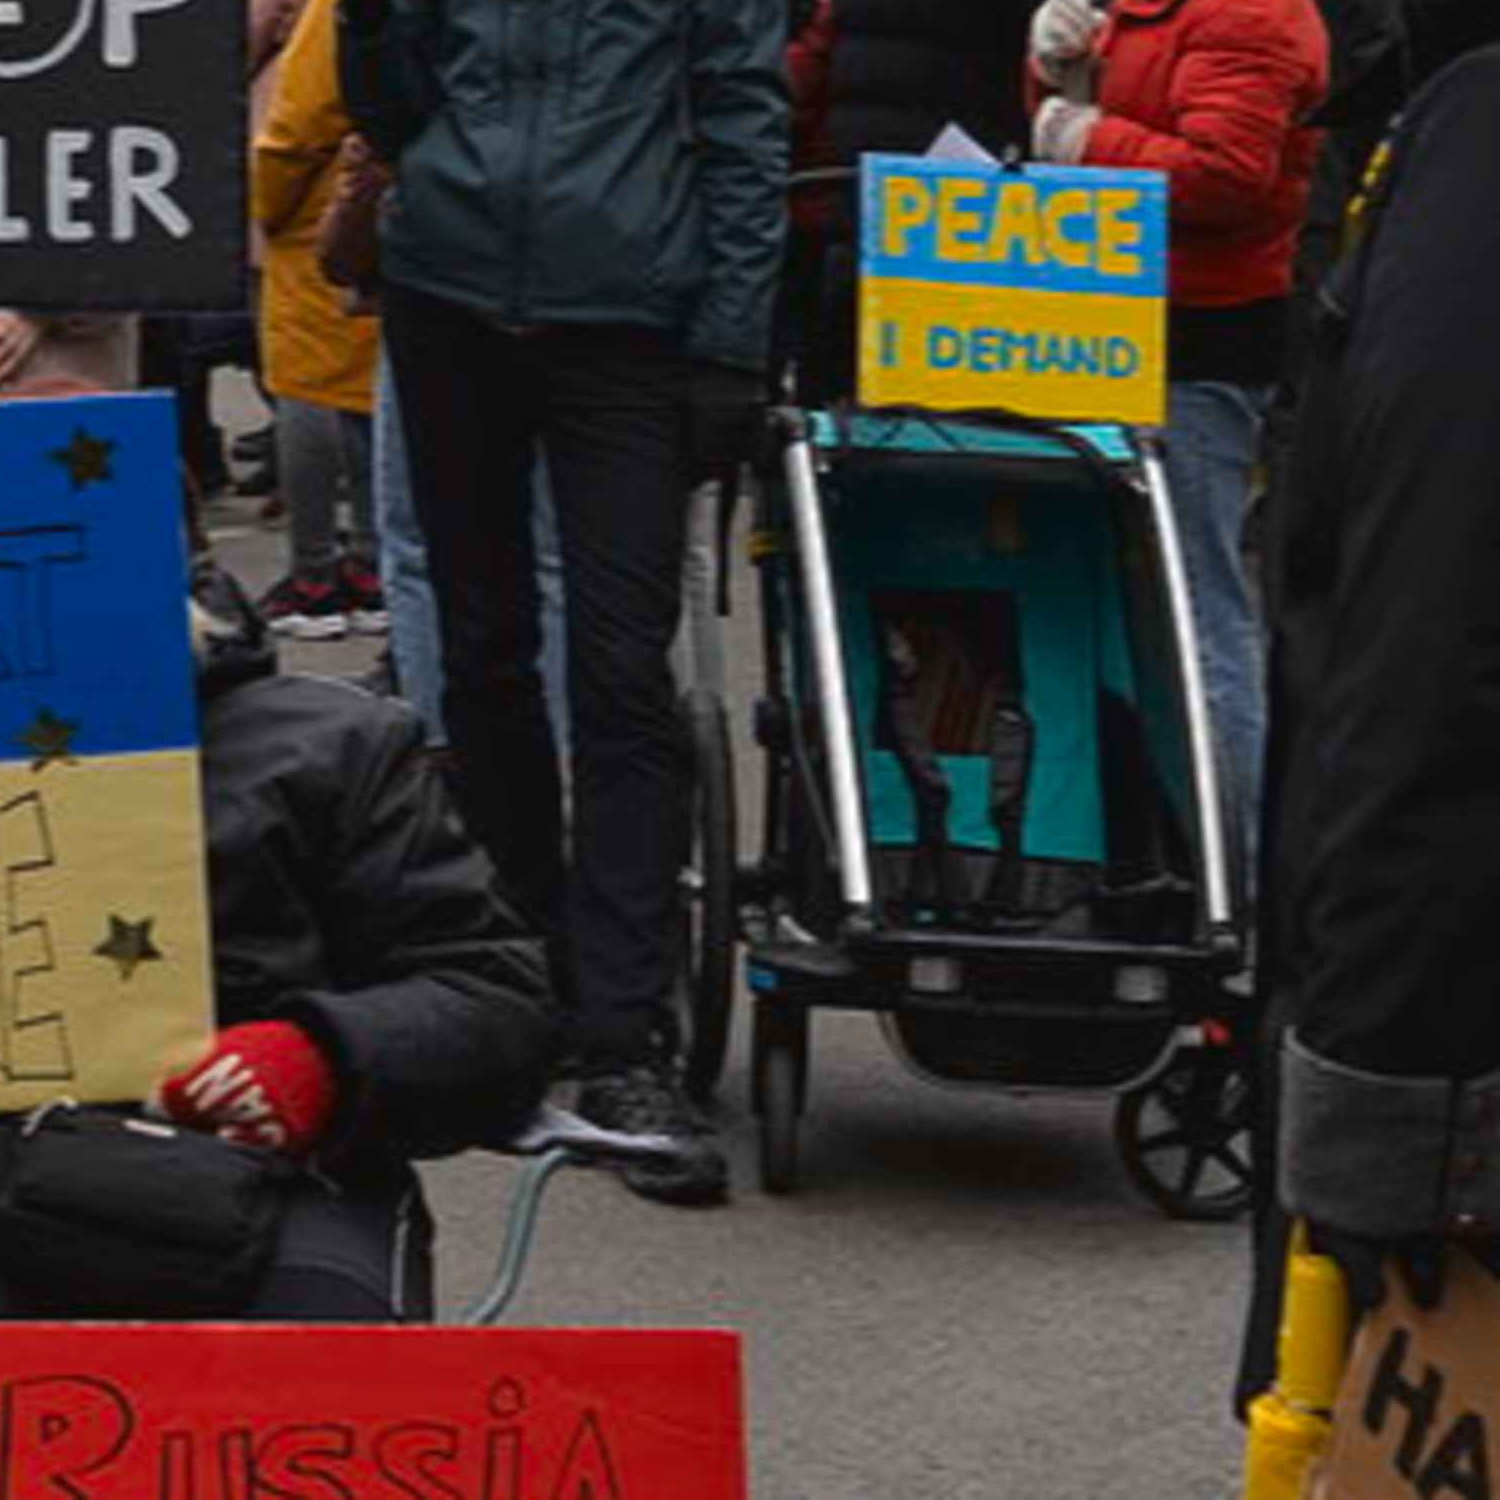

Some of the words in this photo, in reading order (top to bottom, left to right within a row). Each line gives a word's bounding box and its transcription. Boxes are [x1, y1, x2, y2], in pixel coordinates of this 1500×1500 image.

[881, 175, 1143, 276] PEACE
[879, 321, 899, 368] I
[927, 326, 1141, 379] DEMAND
